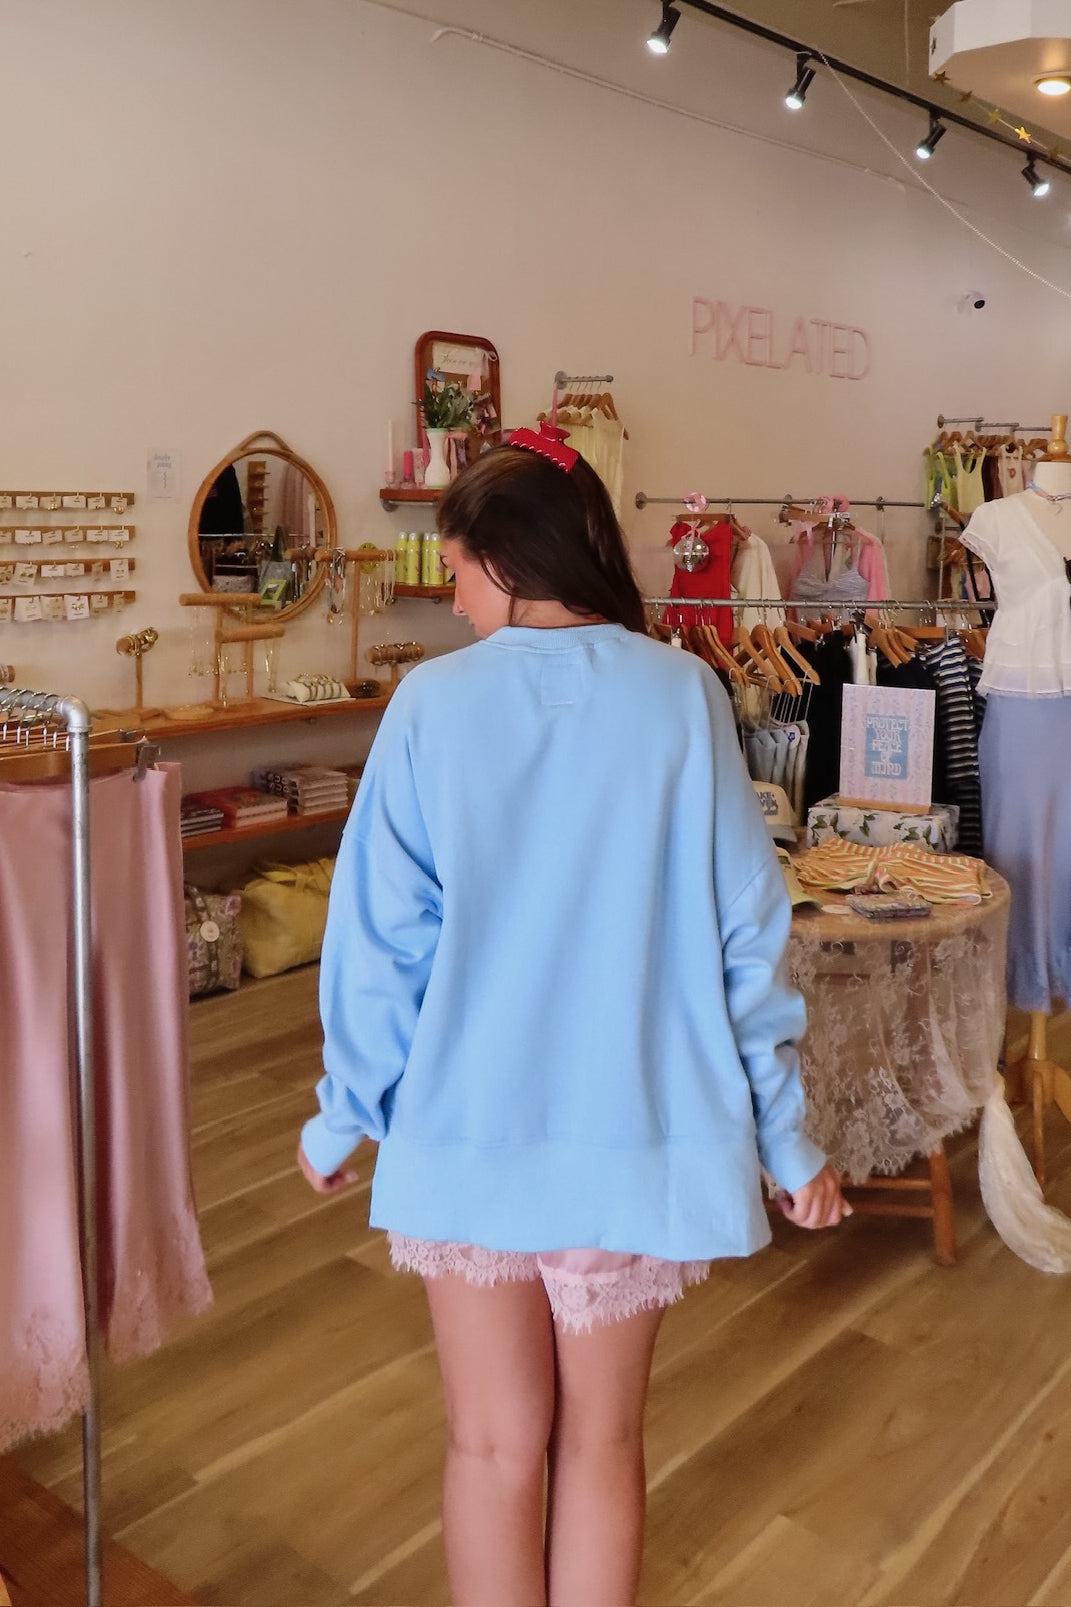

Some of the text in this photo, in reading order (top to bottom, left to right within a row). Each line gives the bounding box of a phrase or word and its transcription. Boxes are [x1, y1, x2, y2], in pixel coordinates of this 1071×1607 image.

[690, 297, 871, 381] PIXELATED
[866, 716, 909, 731] PROTECT
[875, 729, 902, 741] YOUR
[872, 740, 903, 753] PEACE
[871, 761, 902, 776] MIND
